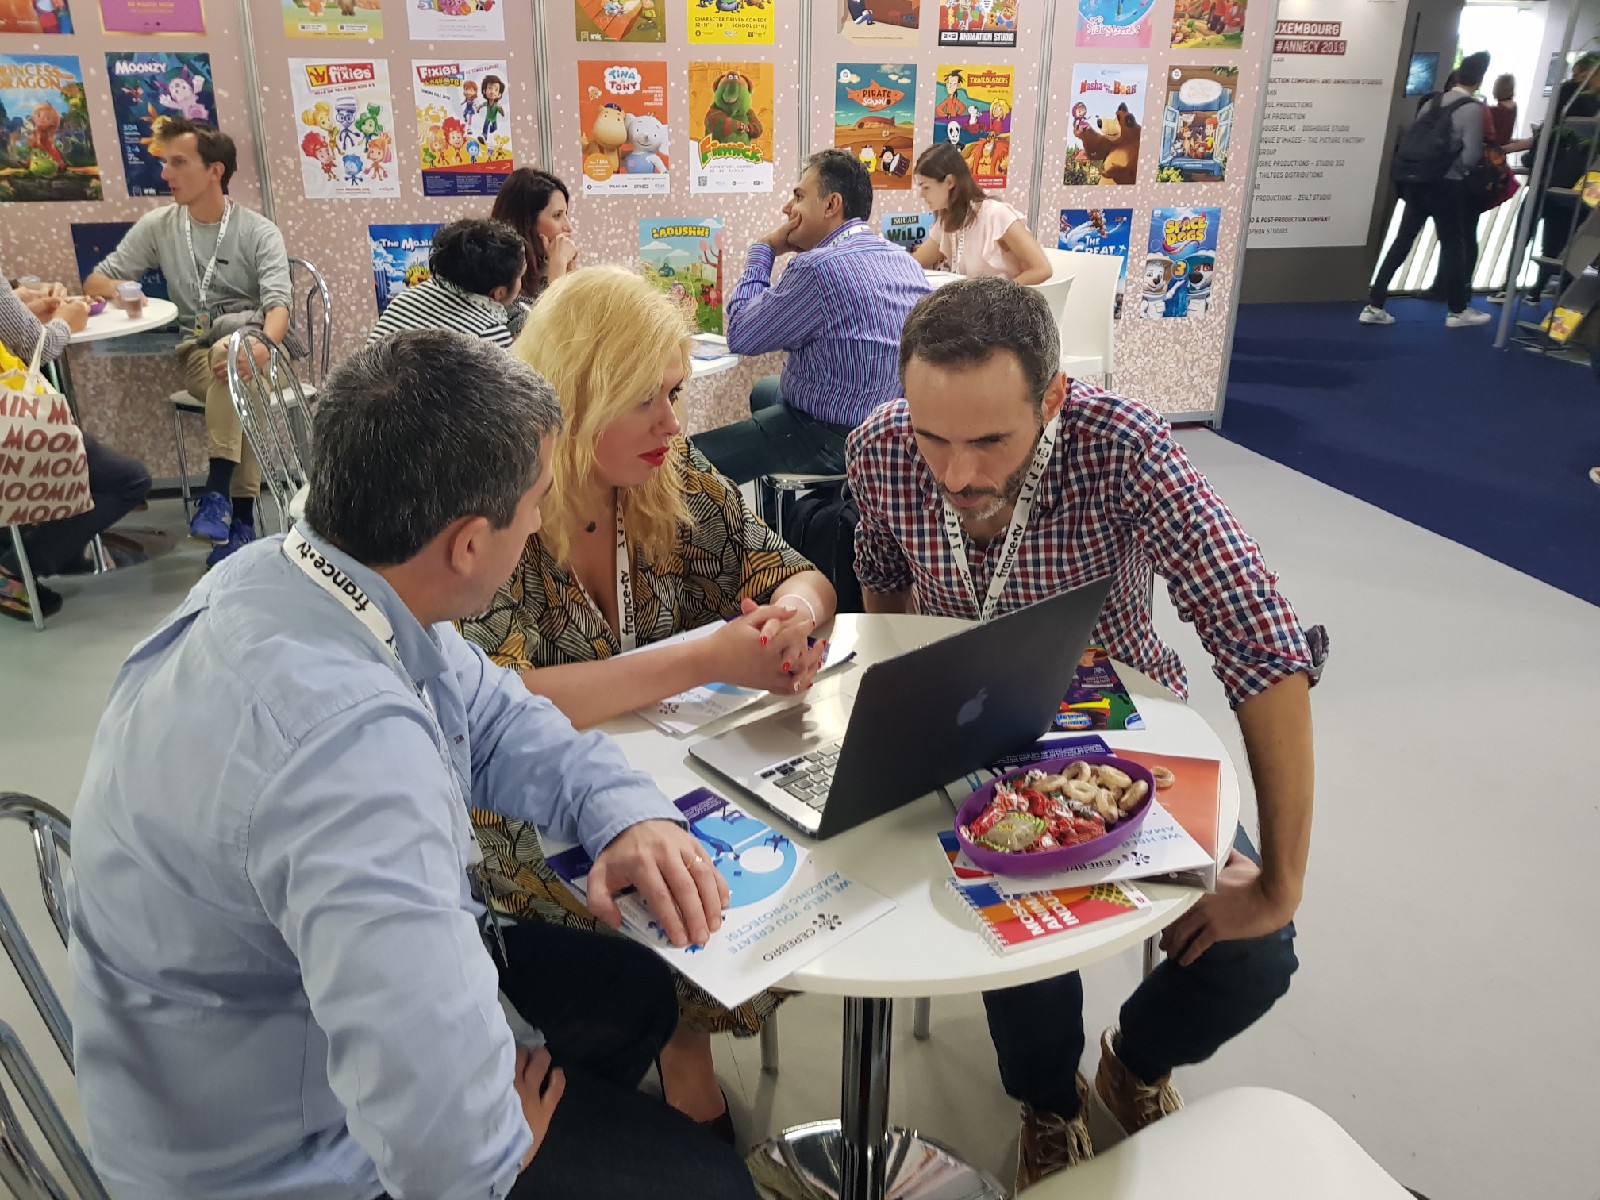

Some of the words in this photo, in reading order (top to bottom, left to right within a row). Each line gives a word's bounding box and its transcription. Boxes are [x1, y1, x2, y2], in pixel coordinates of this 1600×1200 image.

[959, 32, 993, 41] ANIMATION
[993, 32, 1014, 42] STUDIO
[1275, 41, 1320, 53] #ANNECY
[1321, 42, 1346, 54] 2019
[115, 60, 166, 76] MOONZY
[609, 80, 637, 91] TONY
[1080, 79, 1103, 95] Masha
[862, 89, 892, 99] PIRATE
[1165, 217, 1208, 235] SPACE
[379, 238, 399, 248] The
[1085, 235, 1101, 244] THE
[1174, 262, 1187, 277] 3
